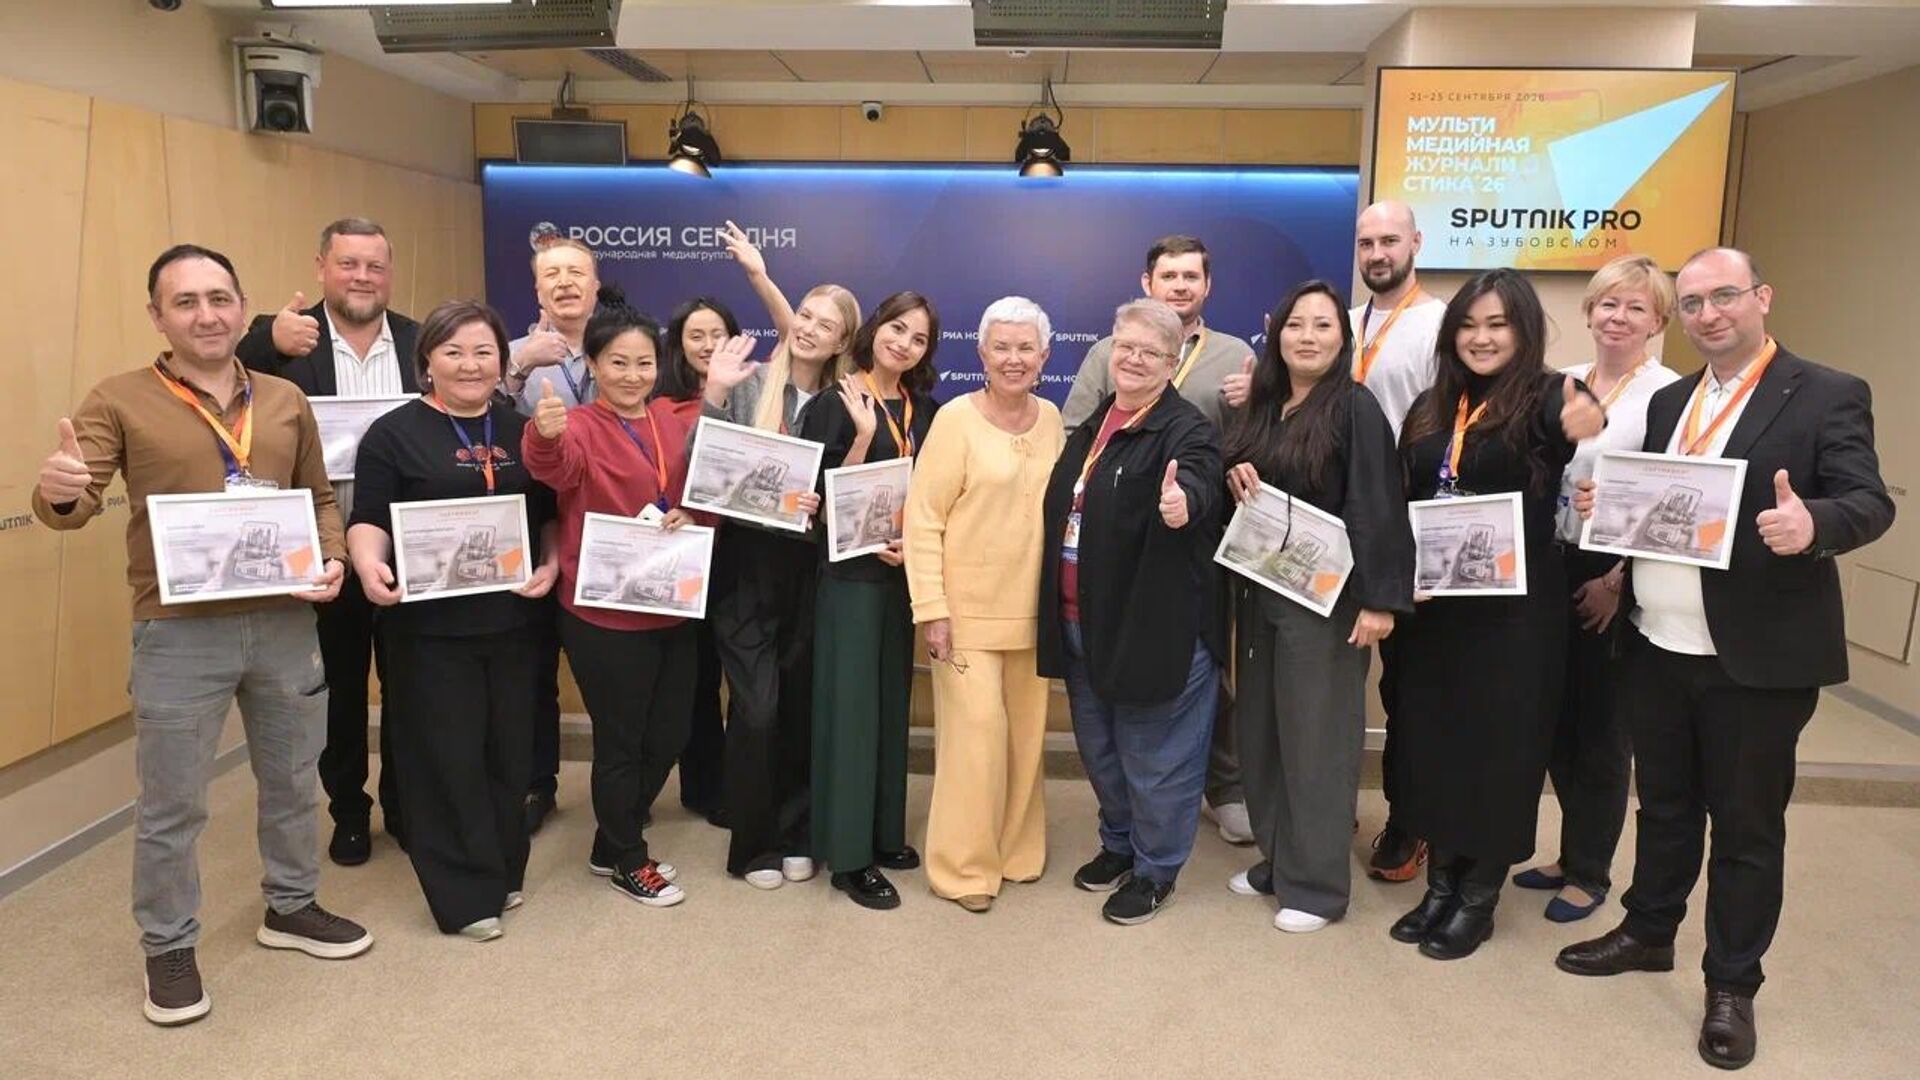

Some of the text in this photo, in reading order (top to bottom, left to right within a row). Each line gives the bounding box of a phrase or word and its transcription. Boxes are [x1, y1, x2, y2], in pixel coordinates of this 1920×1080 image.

[1407, 115, 1496, 133] МУЛЬТИ
[1405, 132, 1531, 154] МЕДИЙНАЯ
[1404, 155, 1517, 173] ЖУРНАЛИ
[1403, 175, 1473, 192] СТИКА
[1450, 207, 1642, 231] SPUTNIK PRO
[568, 226, 797, 250] РОССИЯ СЕГДНЯ
[1450, 236, 1618, 249] НА ЗУБОВСКОМ
[592, 250, 734, 261] дународная медиагруппа
[942, 331, 964, 340] РИА
[1055, 332, 1099, 342] SPUTNIK
[950, 371, 985, 382] SPUTN
[1041, 375, 1061, 383] РИА
[0, 514, 34, 530] UTNIK
